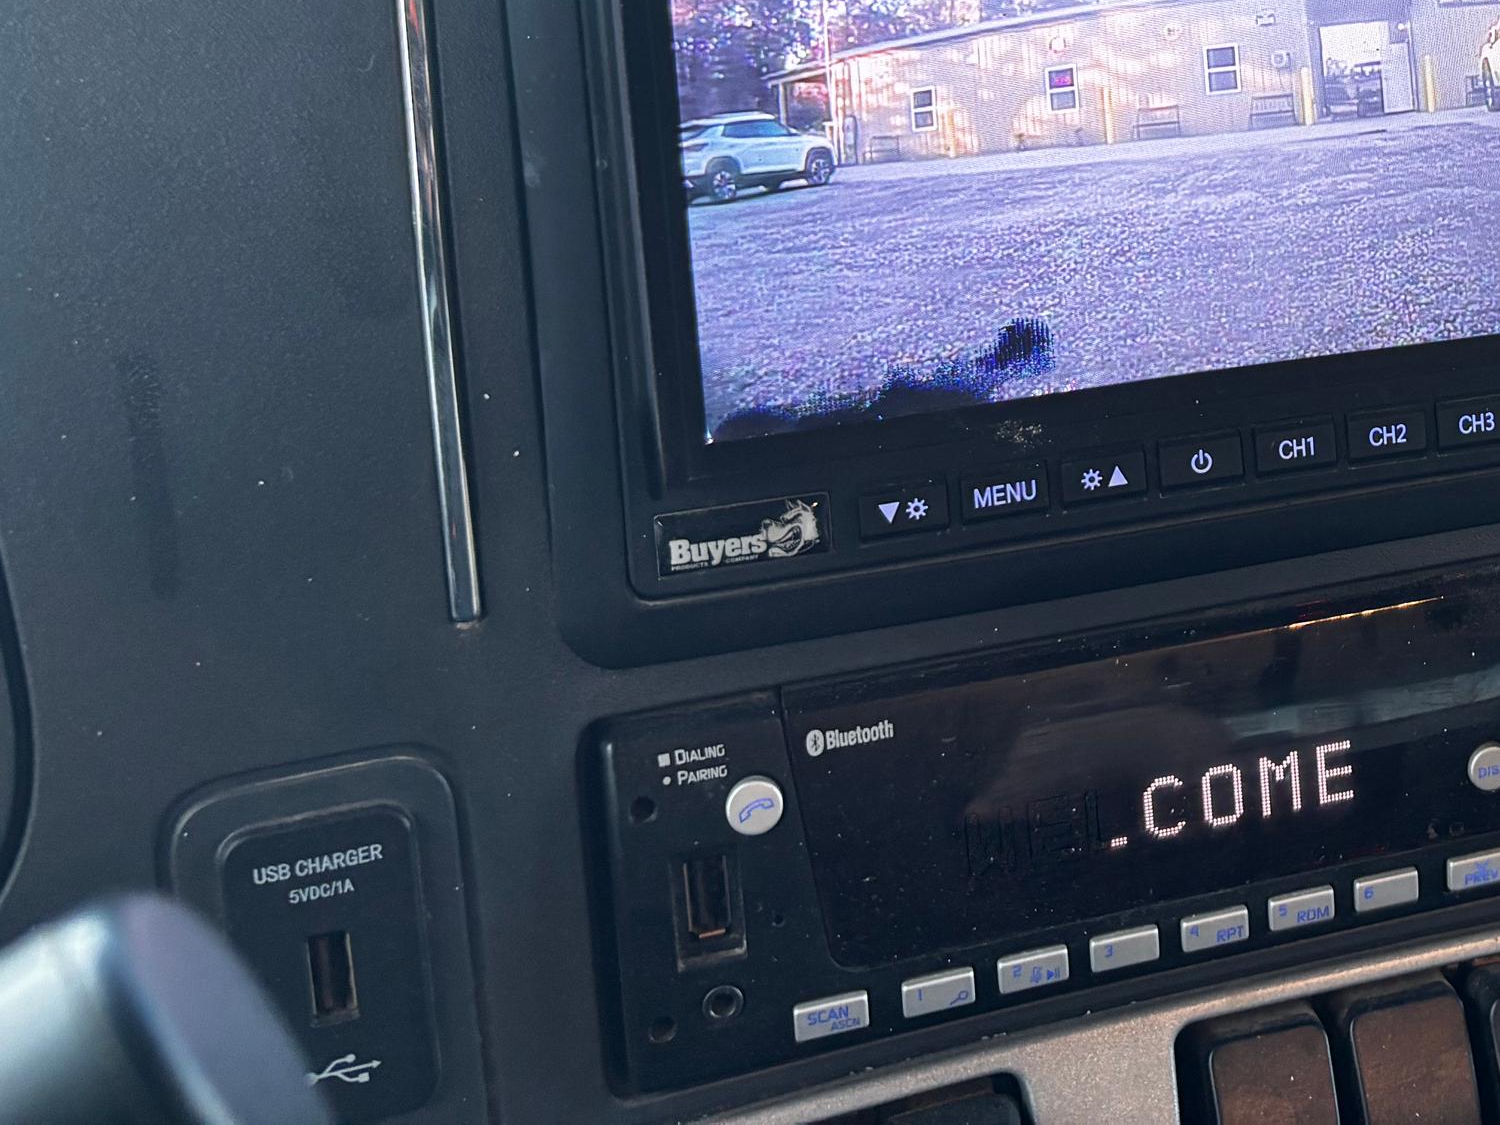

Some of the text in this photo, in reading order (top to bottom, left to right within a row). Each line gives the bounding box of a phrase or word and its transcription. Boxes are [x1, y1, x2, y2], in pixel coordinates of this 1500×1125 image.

[1459, 411, 1495, 435] CH3
[1369, 424, 1407, 447] CH2
[1279, 436, 1316, 460] CH1
[973, 479, 1037, 509] MENU
[669, 534, 767, 566] Buyers
[825, 720, 894, 750] Bluetooth
[253, 844, 383, 885] USB CHARGER
[1463, 868, 1498, 885] PREV
[289, 878, 354, 904] 5VDC/1A
[1364, 886, 1373, 899] 6
[1278, 905, 1287, 917] 5
[1297, 906, 1330, 923] RDM
[1190, 926, 1199, 937] 4
[1216, 926, 1245, 943] RPT
[1104, 945, 1113, 958] 3
[807, 1005, 849, 1025] SCAN
[831, 1018, 861, 1032] ASCN
